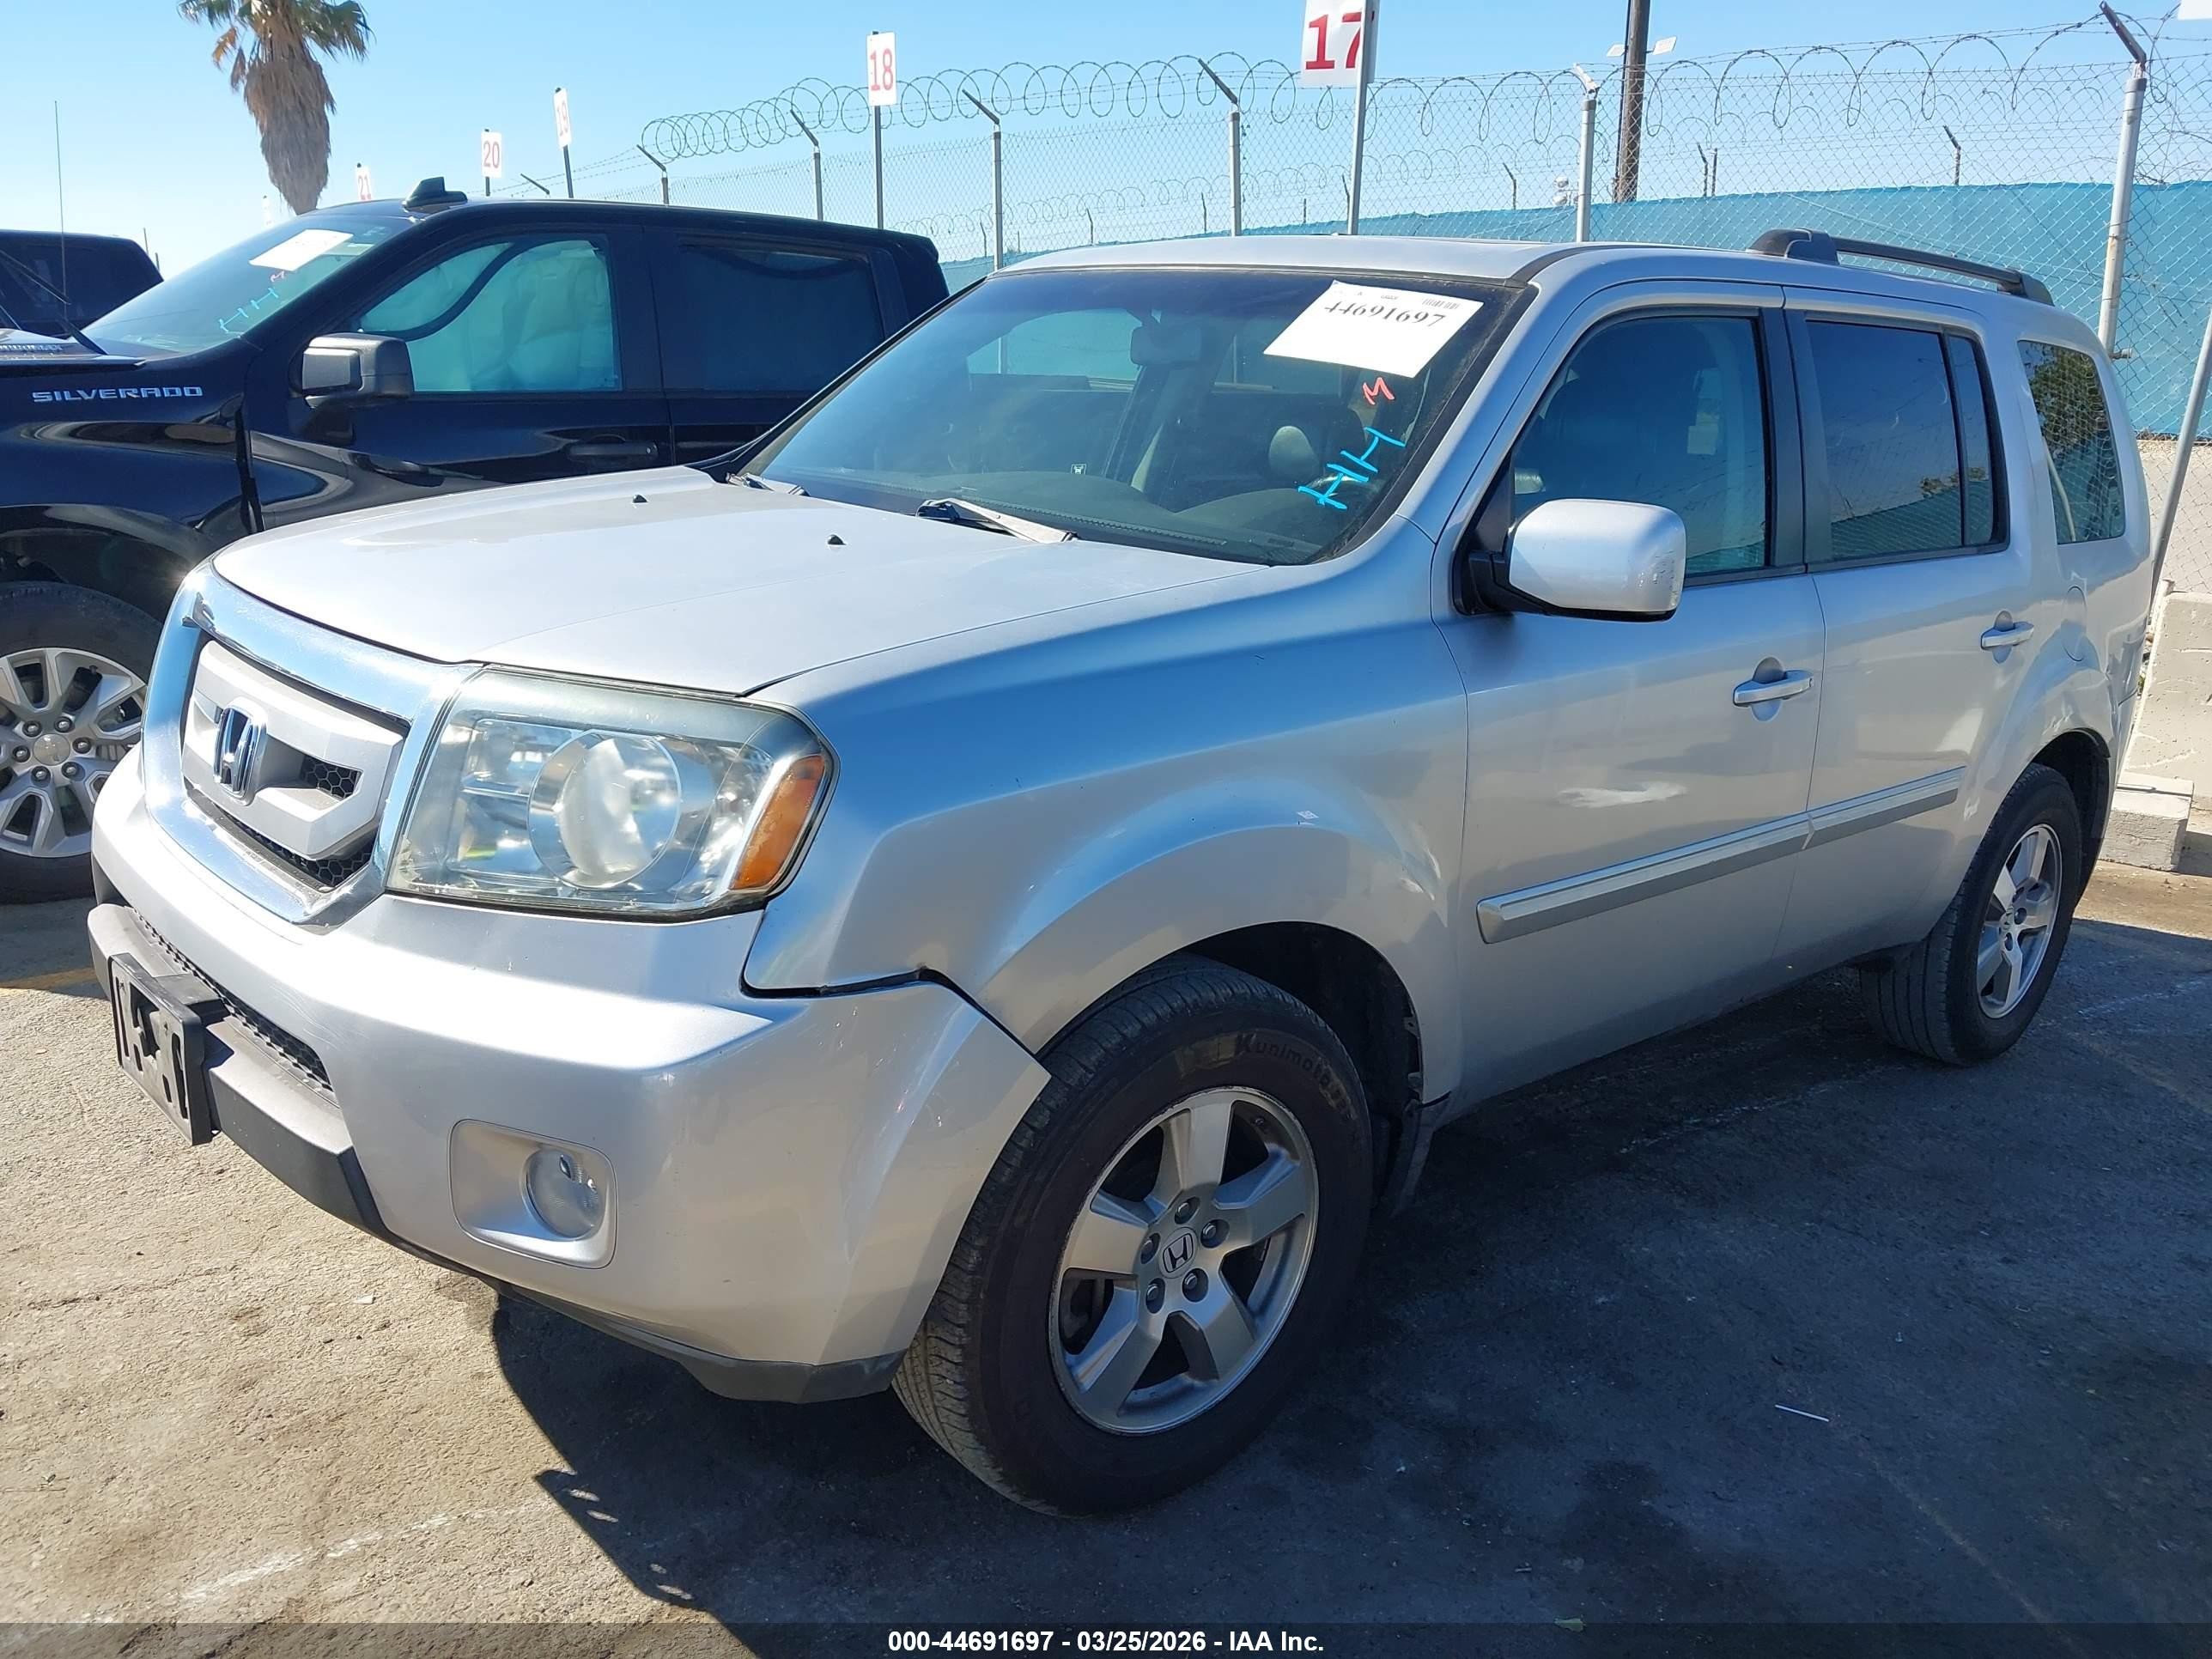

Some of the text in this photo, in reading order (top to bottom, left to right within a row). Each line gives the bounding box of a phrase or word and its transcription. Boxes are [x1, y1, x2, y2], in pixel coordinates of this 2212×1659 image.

[1305, 11, 1365, 70] 17
[870, 48, 894, 91] 18
[556, 100, 569, 137] 19
[483, 140, 501, 169] 20
[357, 174, 372, 200] 21
[1324, 301, 1446, 327] 44691697
[32, 386, 204, 403] SILVERADO
